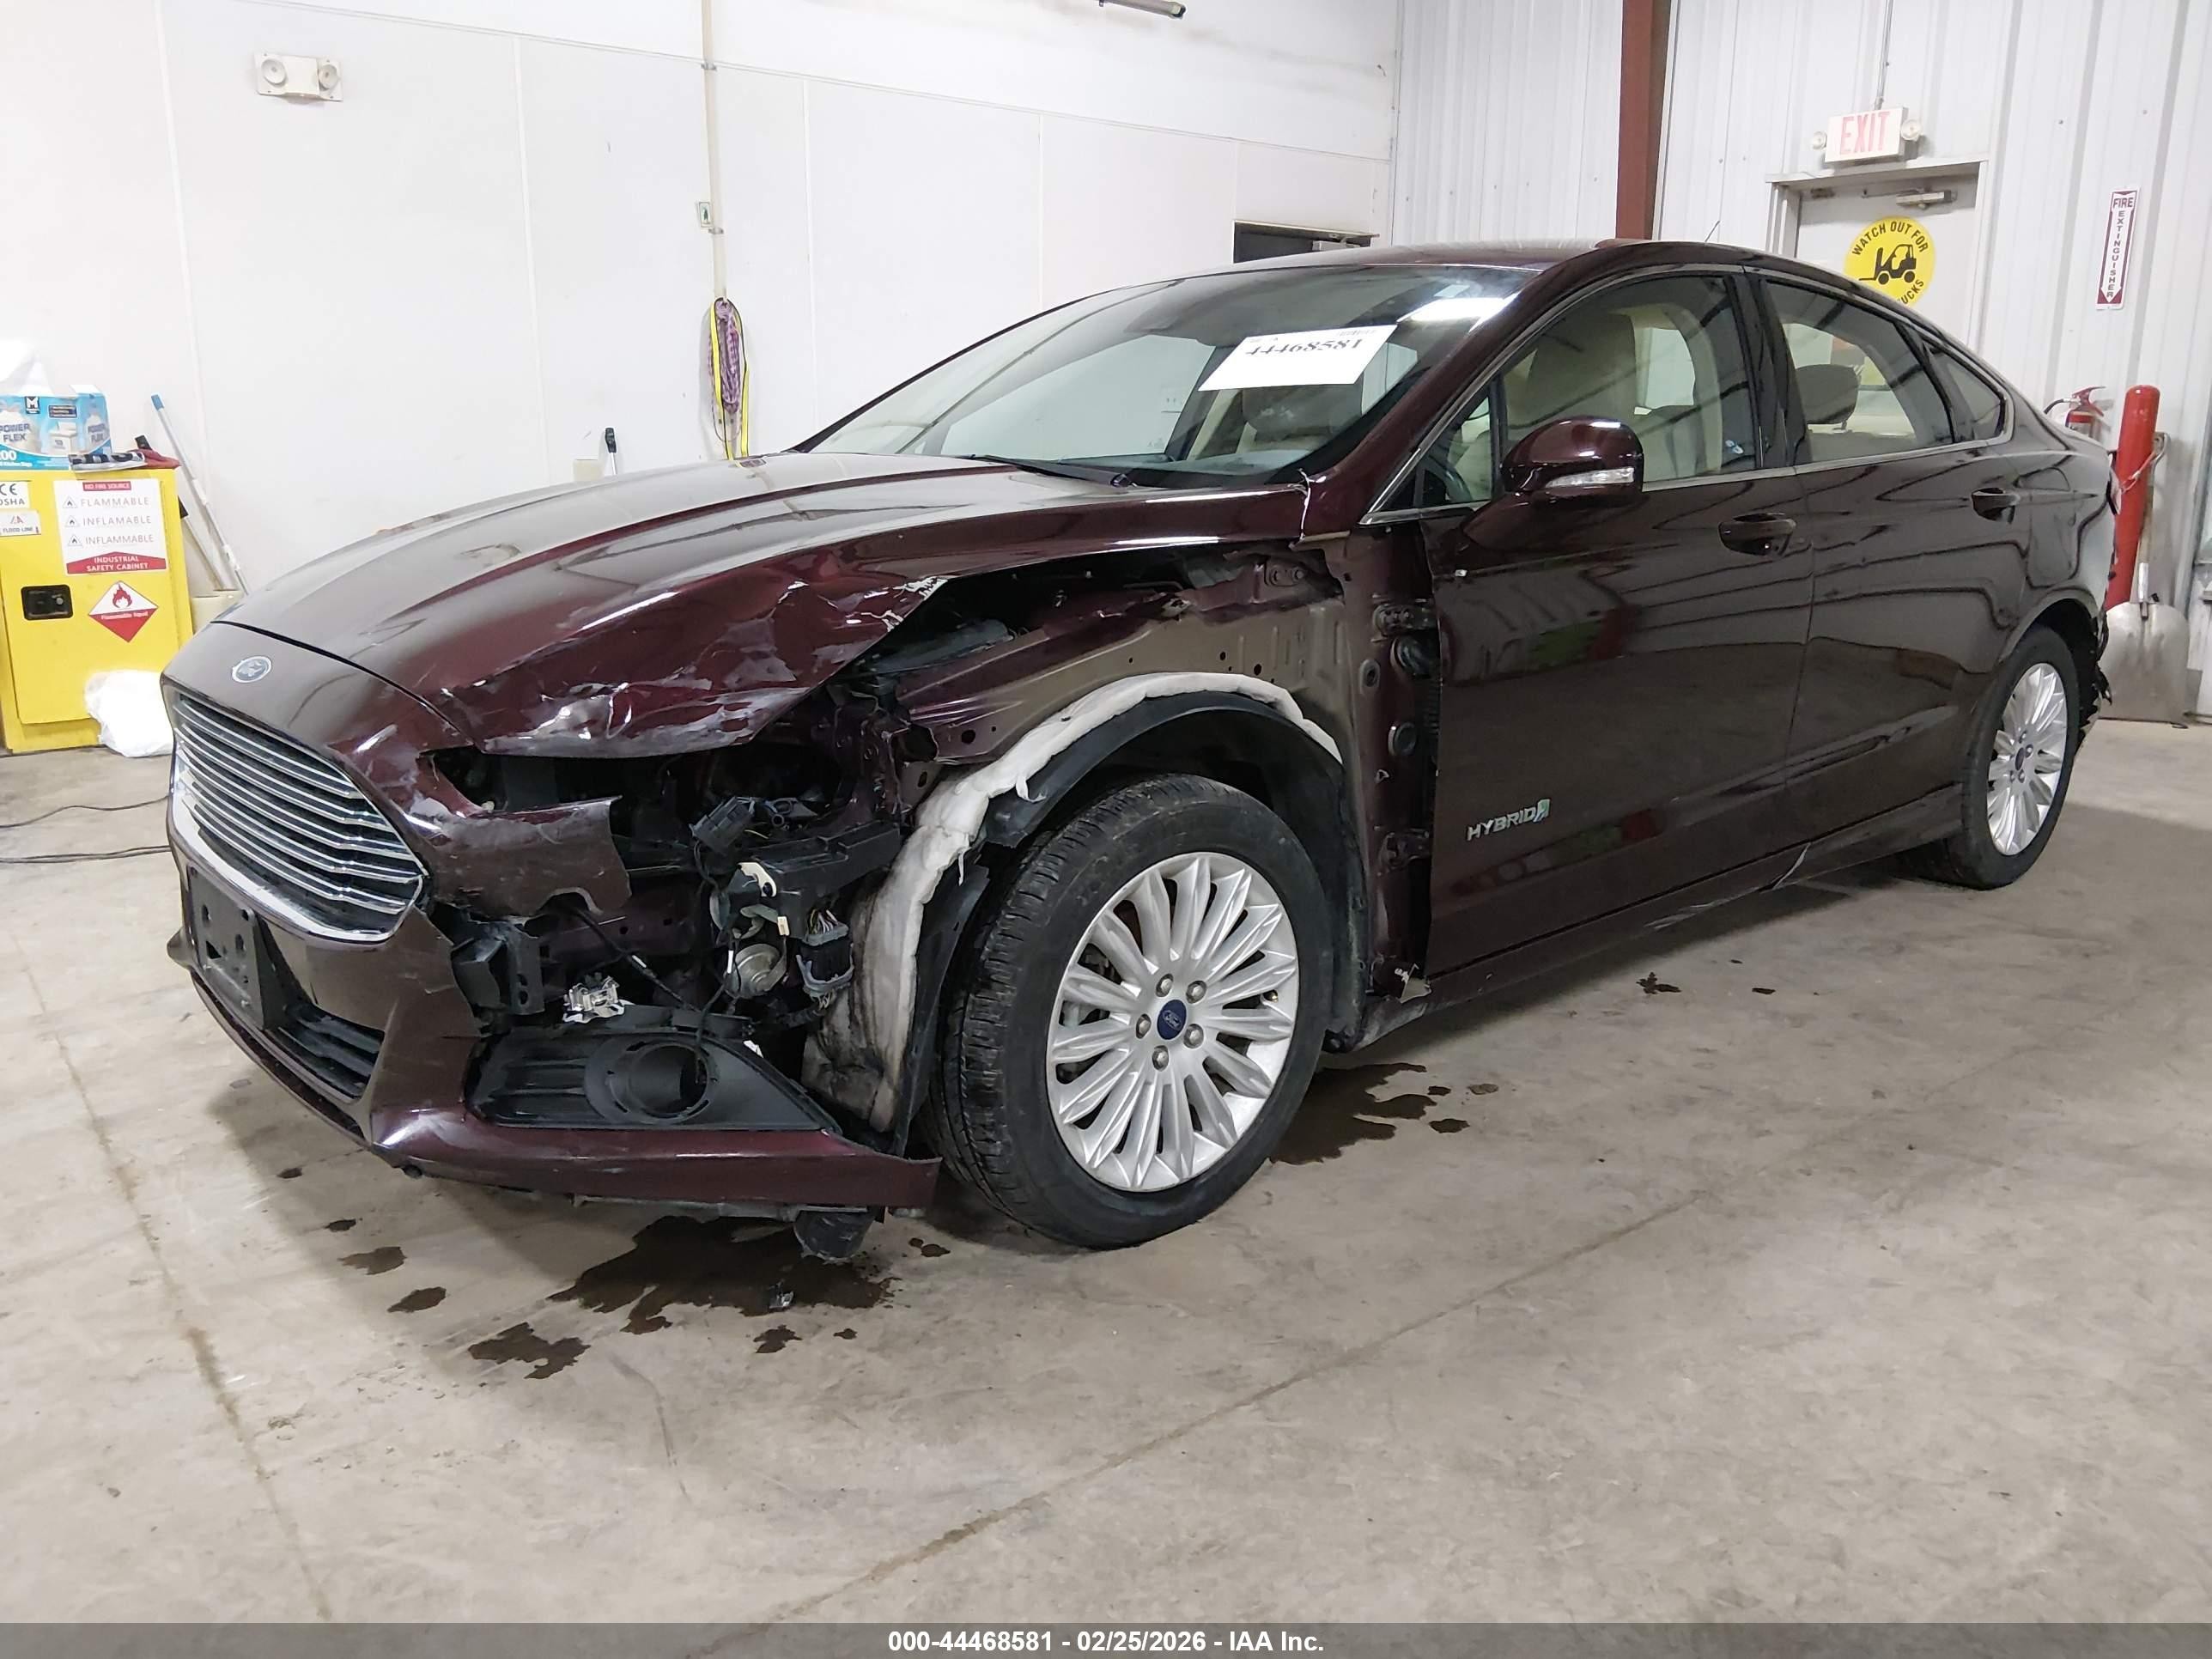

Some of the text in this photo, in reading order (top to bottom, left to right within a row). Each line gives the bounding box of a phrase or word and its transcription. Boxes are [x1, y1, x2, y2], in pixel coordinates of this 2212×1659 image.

[1839, 112, 1891, 155] EXIT
[2113, 197, 2134, 208] FIRE
[1852, 221, 1929, 256] WATCH OUT FOR
[2106, 210, 2126, 298] EXTINGUISHER
[1898, 279, 1924, 305] UCKS
[1245, 338, 1364, 356] 44468581
[3, 433, 26, 442] FLEX
[0, 450, 17, 461] 00
[81, 496, 149, 507] FLAMMABLE
[82, 515, 152, 526] INFLAMABLE
[85, 534, 155, 544] INFLAMMABLE
[94, 556, 139, 564] INDUSTRIAL
[86, 562, 149, 572] SAFETY CABINET
[1467, 806, 1537, 842] HYBRID
